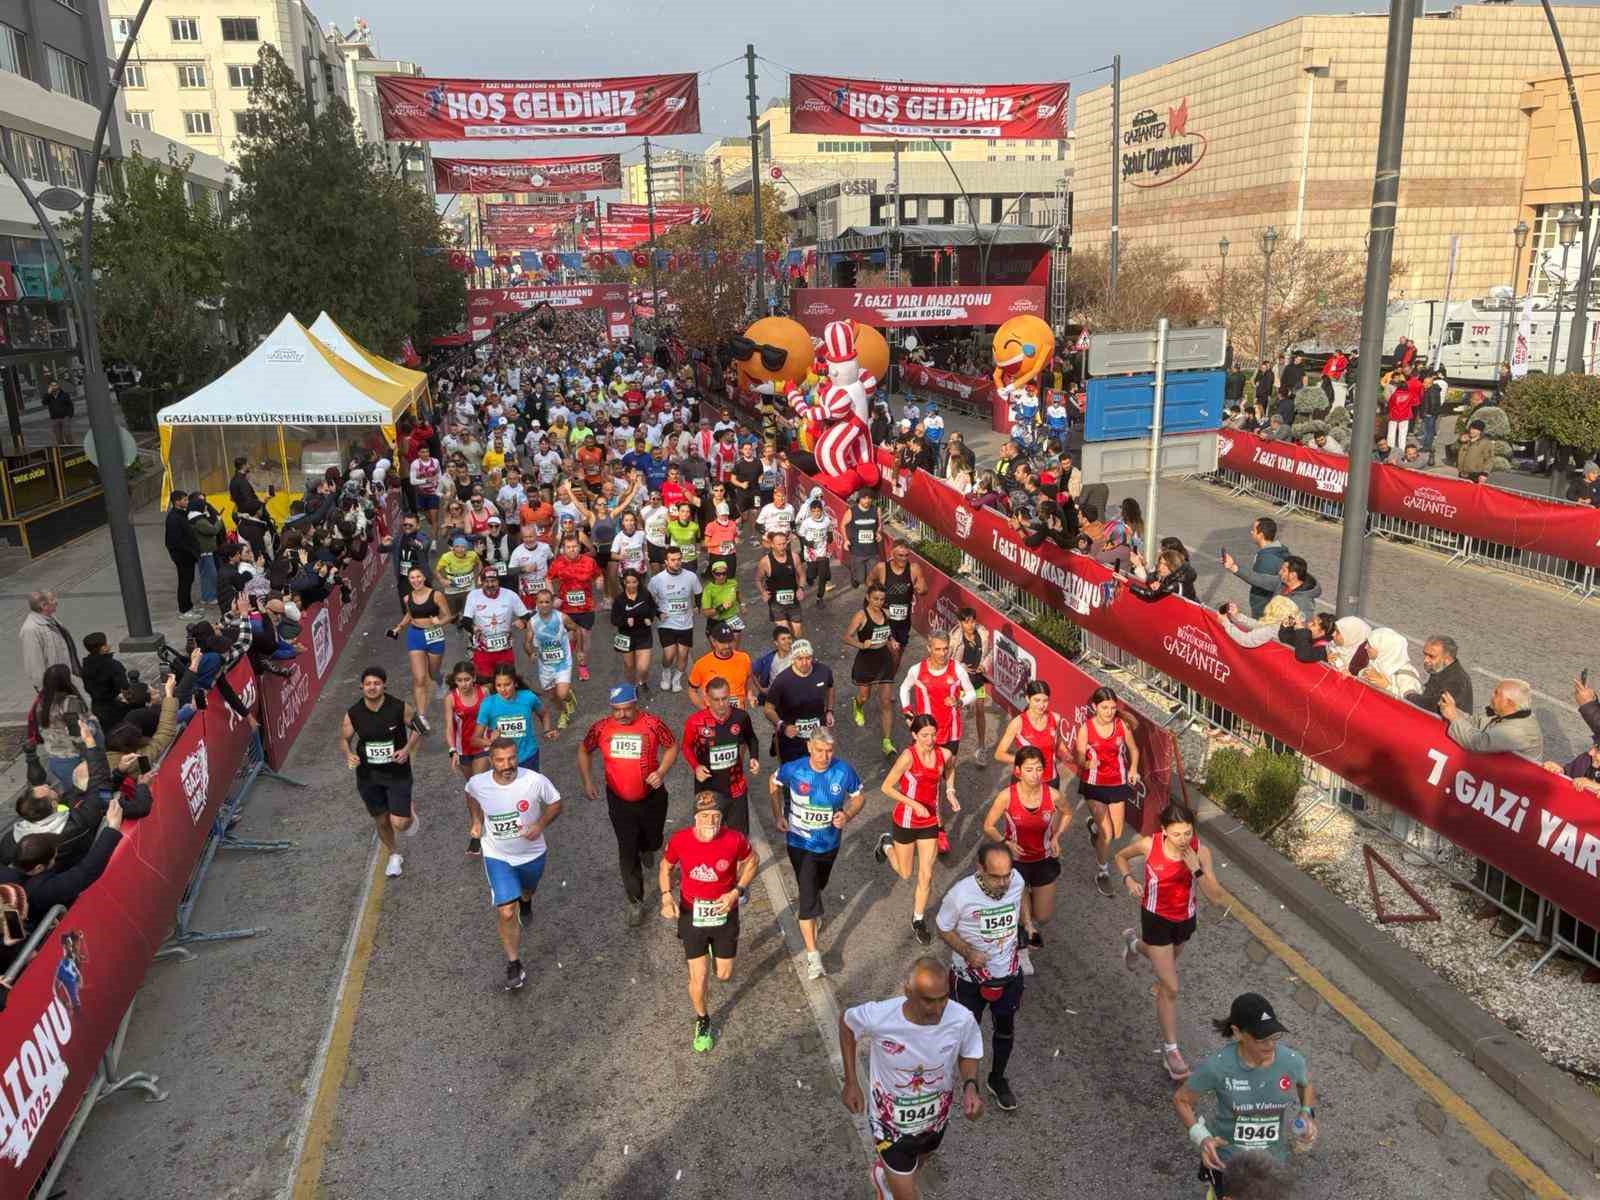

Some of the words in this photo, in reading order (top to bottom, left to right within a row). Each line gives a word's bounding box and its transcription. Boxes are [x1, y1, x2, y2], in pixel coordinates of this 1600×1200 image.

[447, 92, 506, 124] HOŞ
[512, 90, 637, 119] GELDİNİZ
[849, 92, 900, 122] HOŞ
[905, 96, 1014, 121] GELDİNİZ
[896, 294, 923, 307] YARI
[924, 293, 991, 307] MARATONU
[896, 310, 919, 319] HALK
[920, 308, 952, 319] KOŞUSU
[1472, 326, 1490, 336] TRT
[163, 414, 233, 424] GAZİANTEP
[236, 413, 314, 425] BÜYÜKŞEHİR
[316, 413, 383, 424] BELEDİYESİ
[1019, 547, 1041, 576] YARI
[1041, 559, 1101, 609] MARATONU
[500, 720, 523, 731] 1768
[616, 741, 637, 751] 1195
[713, 751, 735, 763] 1401
[804, 811, 829, 822] 1703
[494, 819, 518, 832] 1223
[985, 914, 1013, 929] 1549
[21, 1085, 51, 1140] 2025
[899, 1103, 936, 1124] 1944
[1237, 1125, 1276, 1140] 1946
